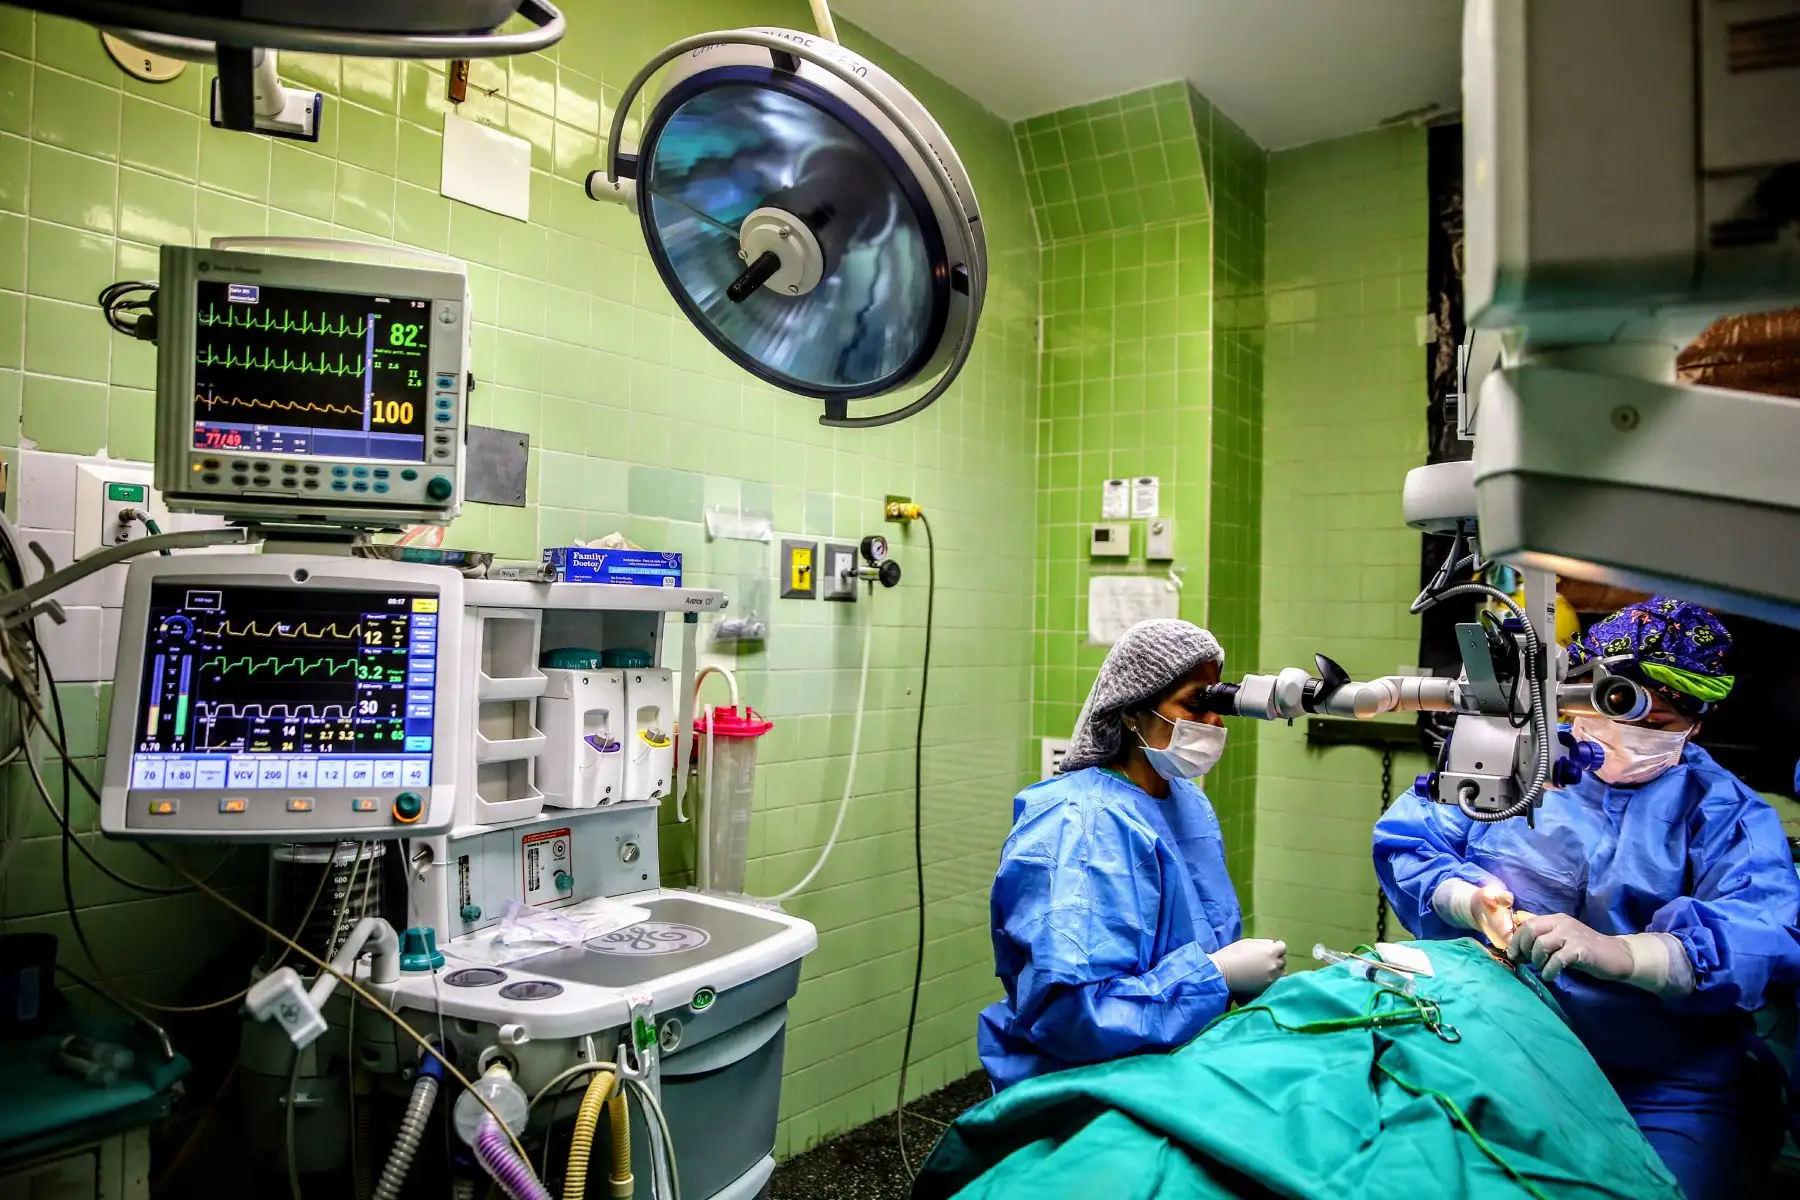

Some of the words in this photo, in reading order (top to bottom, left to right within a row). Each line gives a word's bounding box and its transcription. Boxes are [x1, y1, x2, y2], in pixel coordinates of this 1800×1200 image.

[390, 323, 418, 347] 82
[372, 400, 414, 425] 100
[206, 432, 242, 446] 77/49
[573, 552, 605, 572] Family
[364, 631, 382, 645] 12
[359, 665, 383, 680] 3.2
[359, 700, 378, 715] 30
[282, 725, 297, 736] 14
[338, 731, 355, 740] 3.2
[144, 770, 156, 780] 70
[234, 770, 253, 779] VCV
[264, 770, 281, 779] 200
[297, 771, 308, 779] 14
[353, 771, 366, 779] Off
[382, 771, 394, 779] Off
[410, 771, 422, 779] 40
[334, 876, 348, 884] 600
